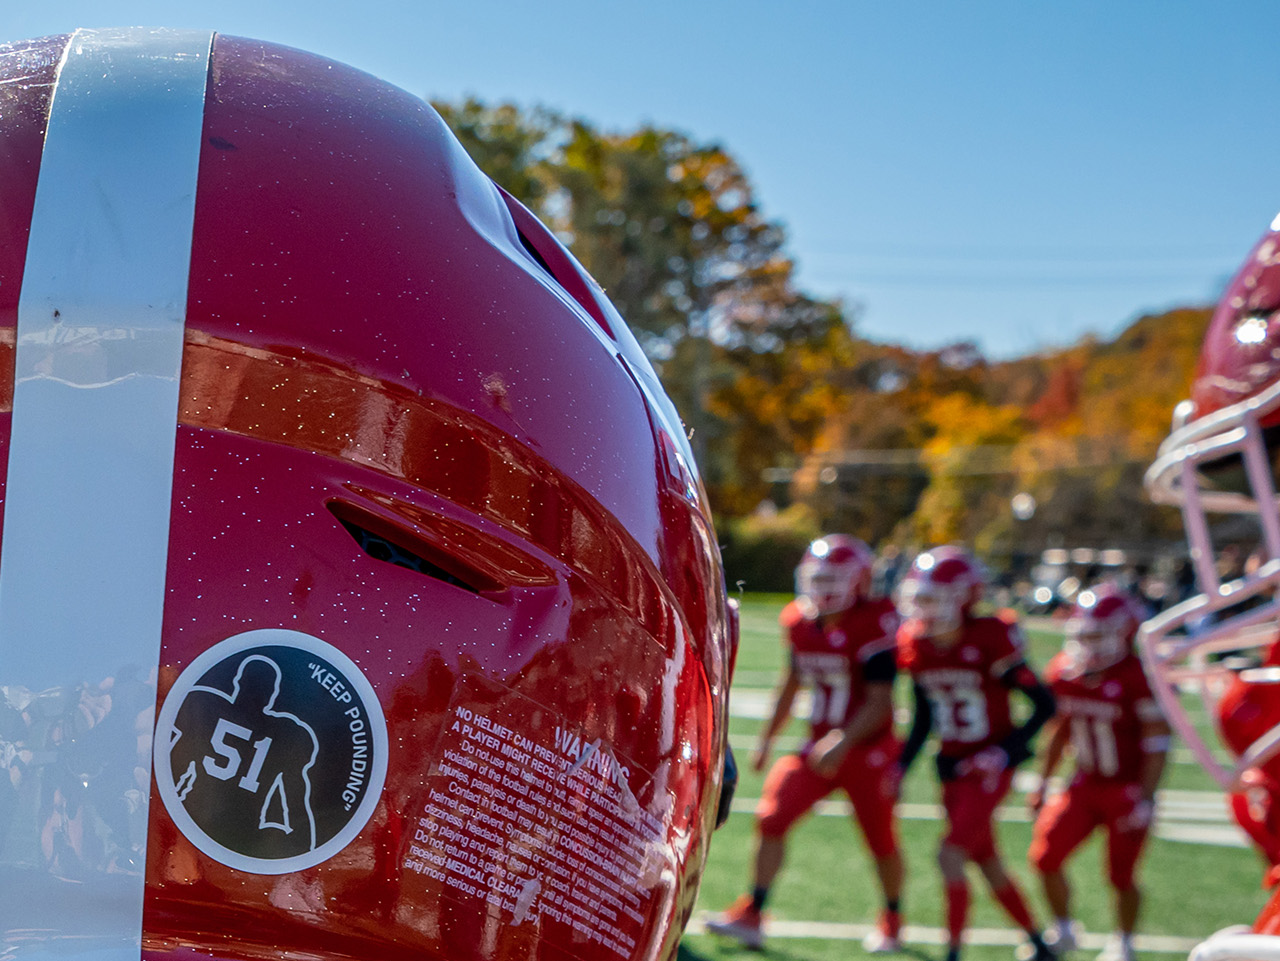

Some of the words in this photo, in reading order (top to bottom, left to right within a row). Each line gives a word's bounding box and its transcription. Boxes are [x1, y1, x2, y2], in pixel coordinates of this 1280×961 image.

[202, 718, 272, 793] 51
[452, 719, 461, 732] A
[461, 723, 500, 751] PLAYER
[500, 742, 530, 766] MIGHT
[530, 758, 566, 784] RECEIVE
[566, 777, 590, 798] WHILE
[456, 706, 472, 721] NO
[473, 713, 512, 742] HELMET
[513, 733, 533, 751] CAN
[533, 744, 572, 772] PREVENT
[461, 739, 475, 754] Do
[475, 748, 489, 761] not
[489, 755, 505, 768] use
[505, 761, 520, 776] this
[520, 768, 545, 788] helmet
[545, 781, 552, 792] to
[429, 788, 458, 809] helmet
[458, 803, 474, 816] can
[474, 811, 505, 830] prevent.
[504, 822, 542, 850] Symptoms
[437, 759, 471, 784] injuries,
[470, 778, 506, 801] paralysis
[506, 795, 515, 805] or
[515, 797, 537, 815] death
[537, 808, 545, 819] to
[557, 821, 571, 833] and
[570, 828, 595, 845] possible
[443, 748, 478, 772] violation
[478, 765, 488, 775] of
[487, 767, 501, 782] the
[501, 774, 528, 795] football
[528, 790, 547, 805] rules
[560, 808, 576, 821] such
[587, 822, 599, 834] can
[448, 780, 480, 803] Contact
[480, 796, 489, 807] in
[489, 800, 517, 820] football
[516, 815, 533, 831] may
[414, 829, 429, 843] Do
[428, 837, 443, 849] not
[444, 844, 468, 860] return
[468, 853, 477, 864] to
[478, 859, 483, 867] a
[484, 861, 506, 877] game
[507, 872, 515, 881] or
[418, 818, 438, 834] stop
[438, 826, 469, 847] playing
[469, 839, 485, 852] and
[485, 847, 508, 862] report
[528, 865, 535, 875] to
[550, 878, 571, 894] coach,
[424, 802, 465, 829] dizziness,
[464, 819, 505, 847] headache,
[532, 853, 540, 863] or
[404, 859, 423, 872] and
[422, 866, 445, 882] more
[446, 875, 476, 894] serious
[476, 889, 485, 899] or
[486, 891, 502, 906] fatal
[502, 898, 516, 912] bra
[409, 845, 445, 866] received
[445, 857, 487, 883] MEDICAL
